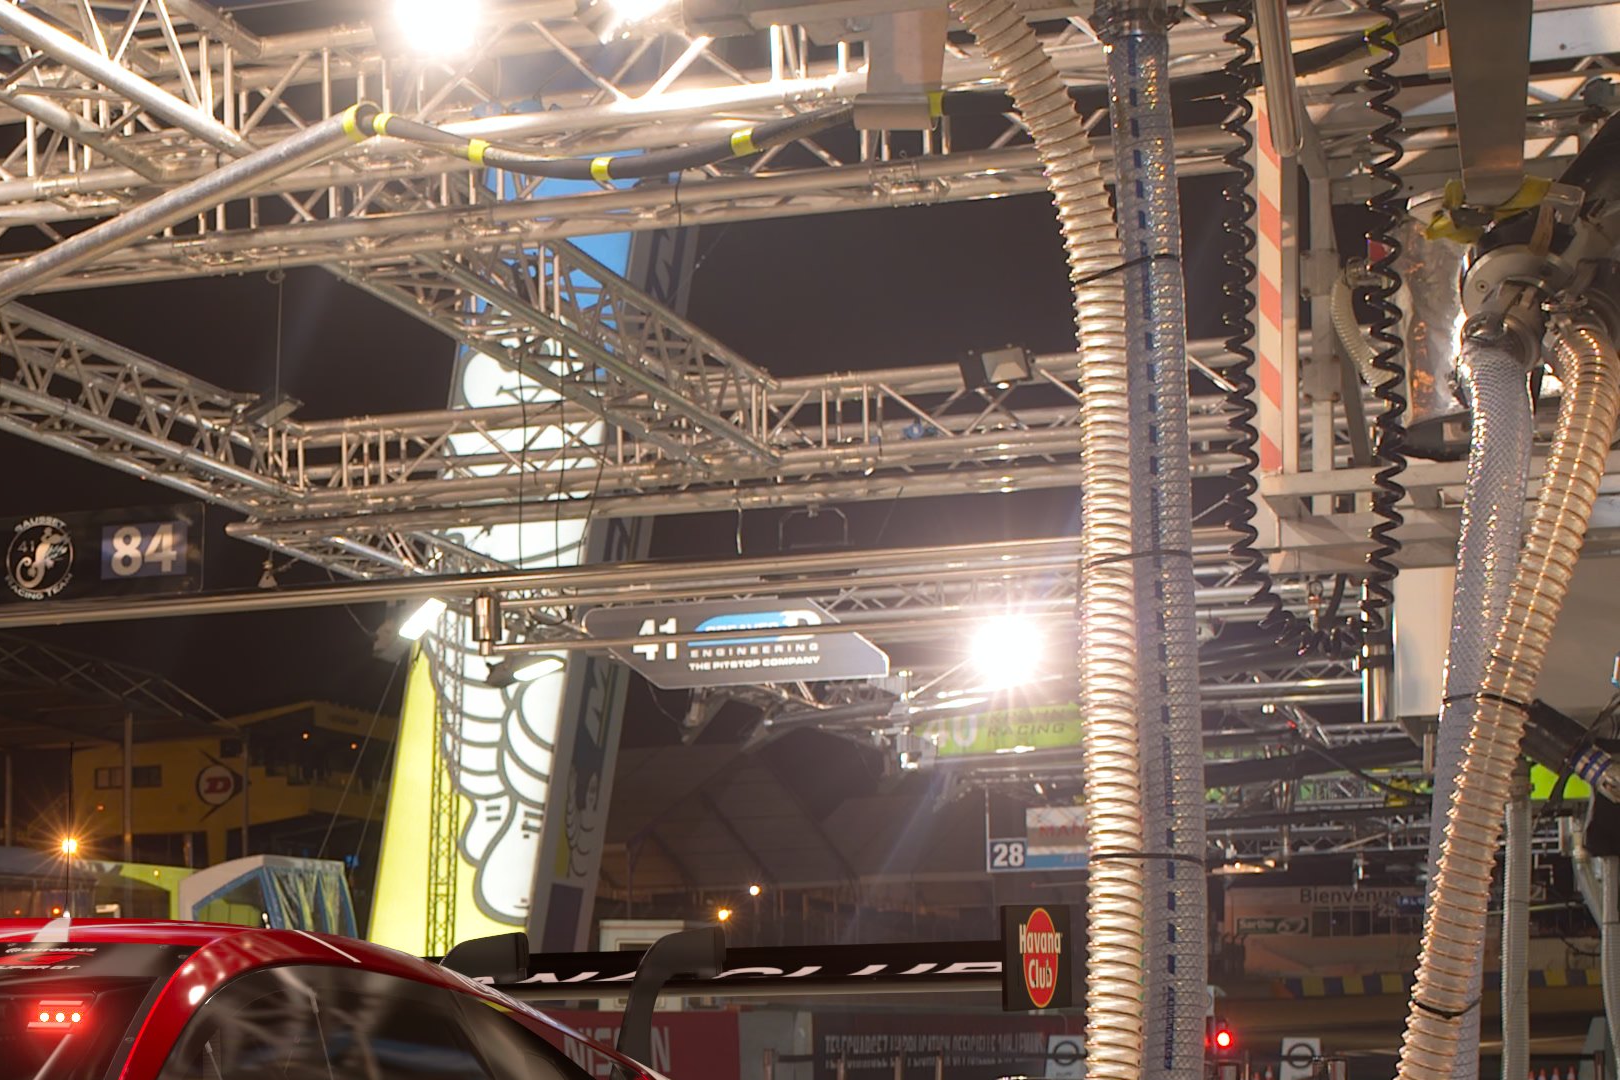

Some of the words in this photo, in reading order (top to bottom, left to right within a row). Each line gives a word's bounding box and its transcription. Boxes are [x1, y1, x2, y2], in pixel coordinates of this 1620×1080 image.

[111, 523, 178, 577] 84
[632, 617, 677, 661] 41
[690, 642, 820, 660] ENGINEERING
[688, 662, 711, 672] THE
[712, 658, 761, 670] PITSTOP
[762, 655, 821, 667] COMPANY
[992, 842, 1024, 867] 28
[1300, 887, 1401, 905] Bienvenue
[1018, 923, 1062, 954] Havana
[1028, 958, 1053, 989] Club
